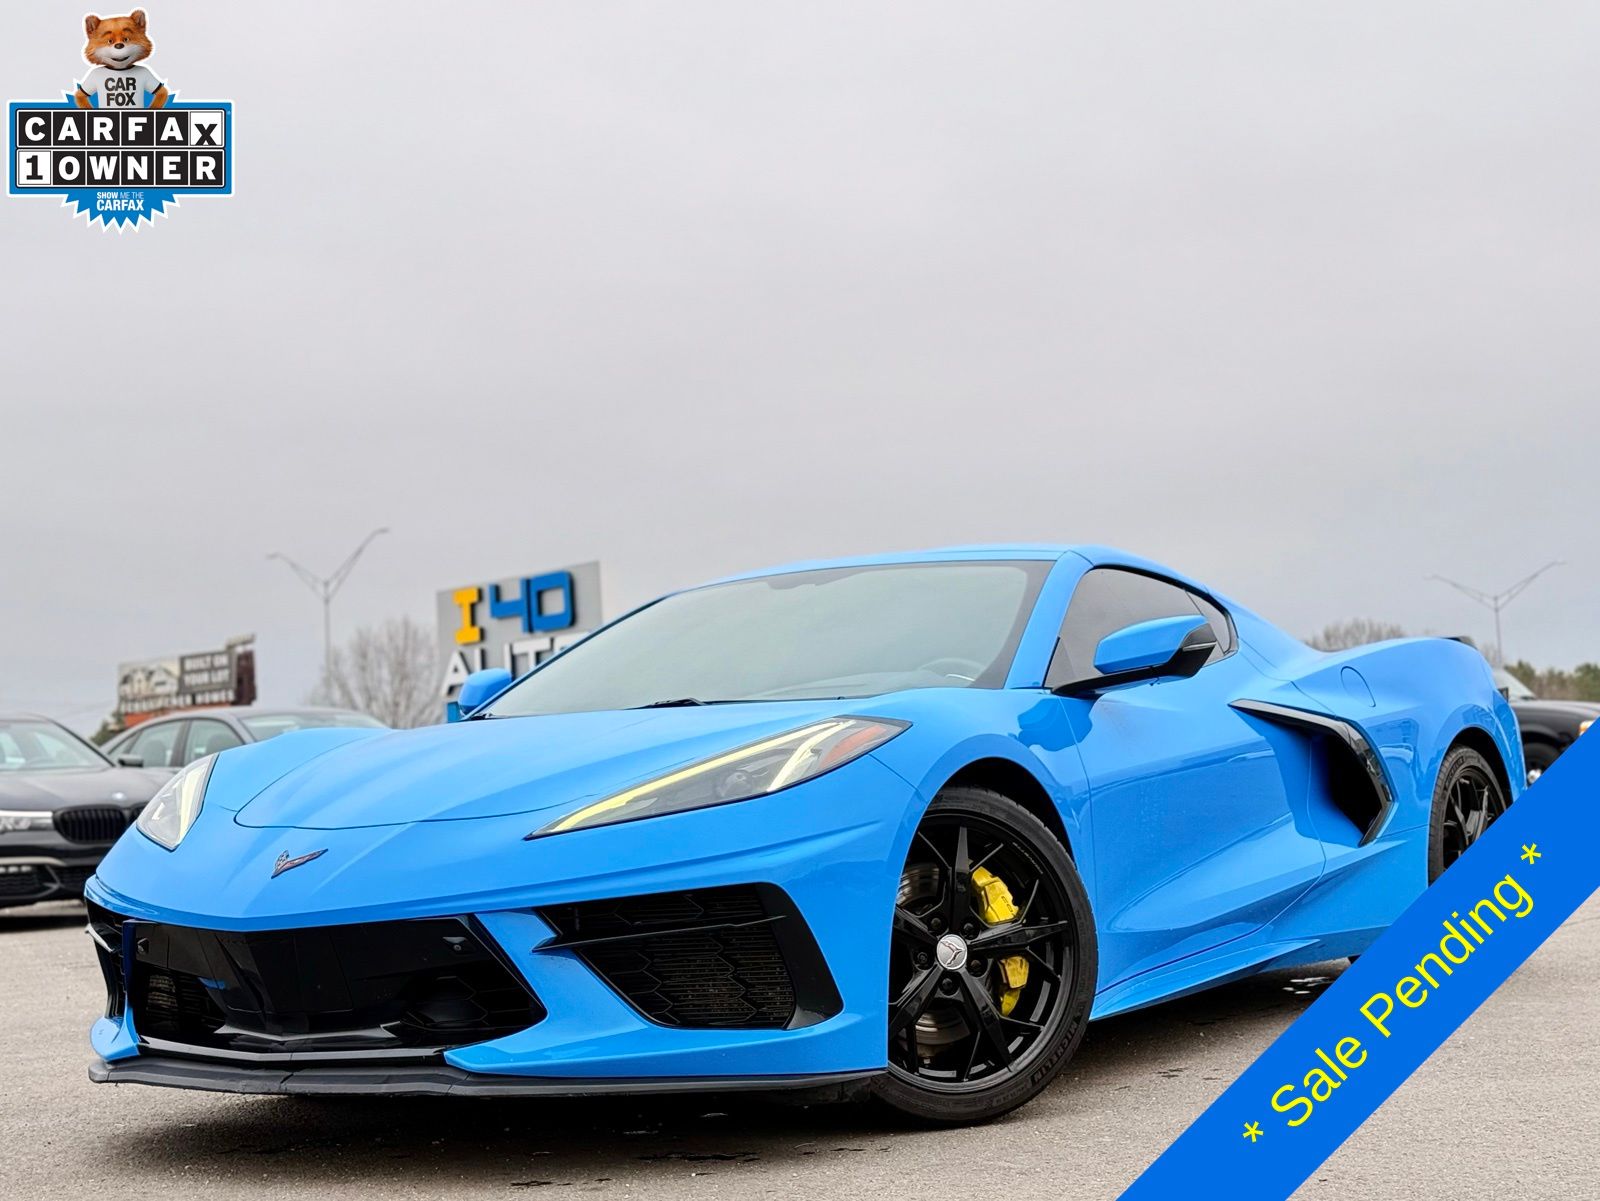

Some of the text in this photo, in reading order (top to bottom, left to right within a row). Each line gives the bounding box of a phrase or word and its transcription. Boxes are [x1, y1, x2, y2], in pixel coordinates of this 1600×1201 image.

[184, 652, 229, 670] BUILT ON
[184, 669, 230, 686] YOUR LOT
